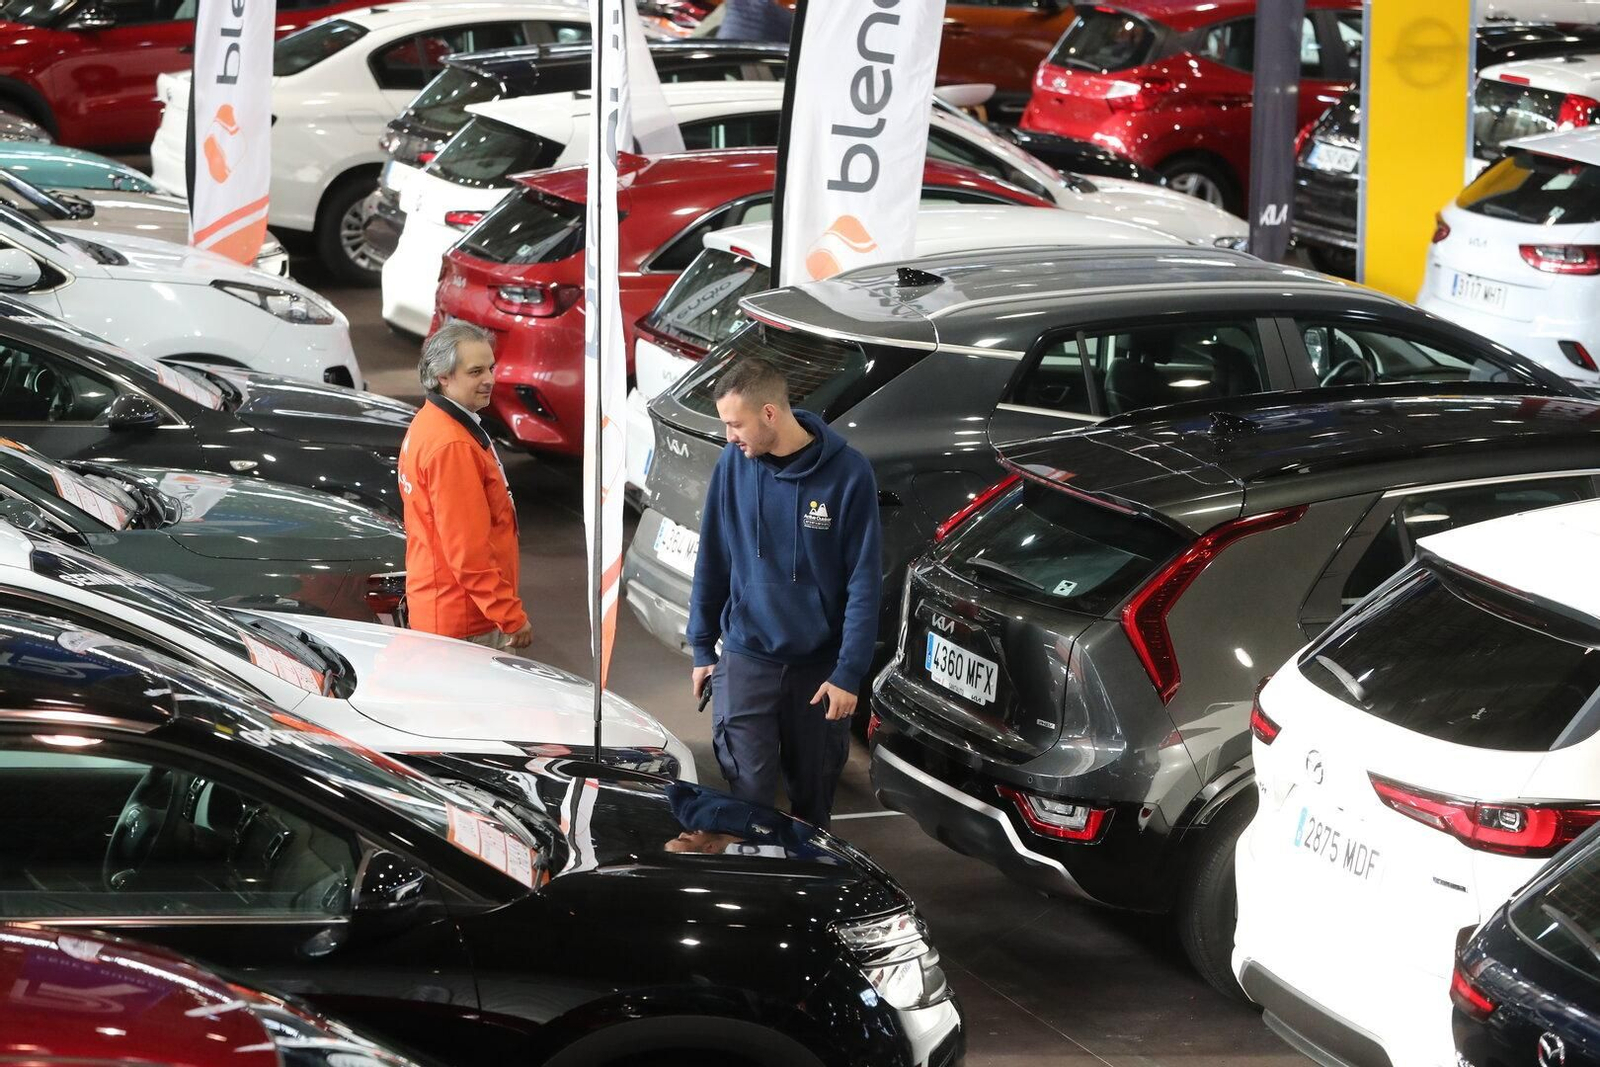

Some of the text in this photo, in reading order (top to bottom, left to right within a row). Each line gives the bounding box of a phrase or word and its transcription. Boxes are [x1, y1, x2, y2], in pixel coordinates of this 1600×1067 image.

[827, 0, 900, 193] blen
[666, 436, 689, 458] KIA
[931, 612, 955, 634] KIA
[933, 642, 994, 696] 4360 MFX
[1304, 816, 1380, 880] 2875 MDF
